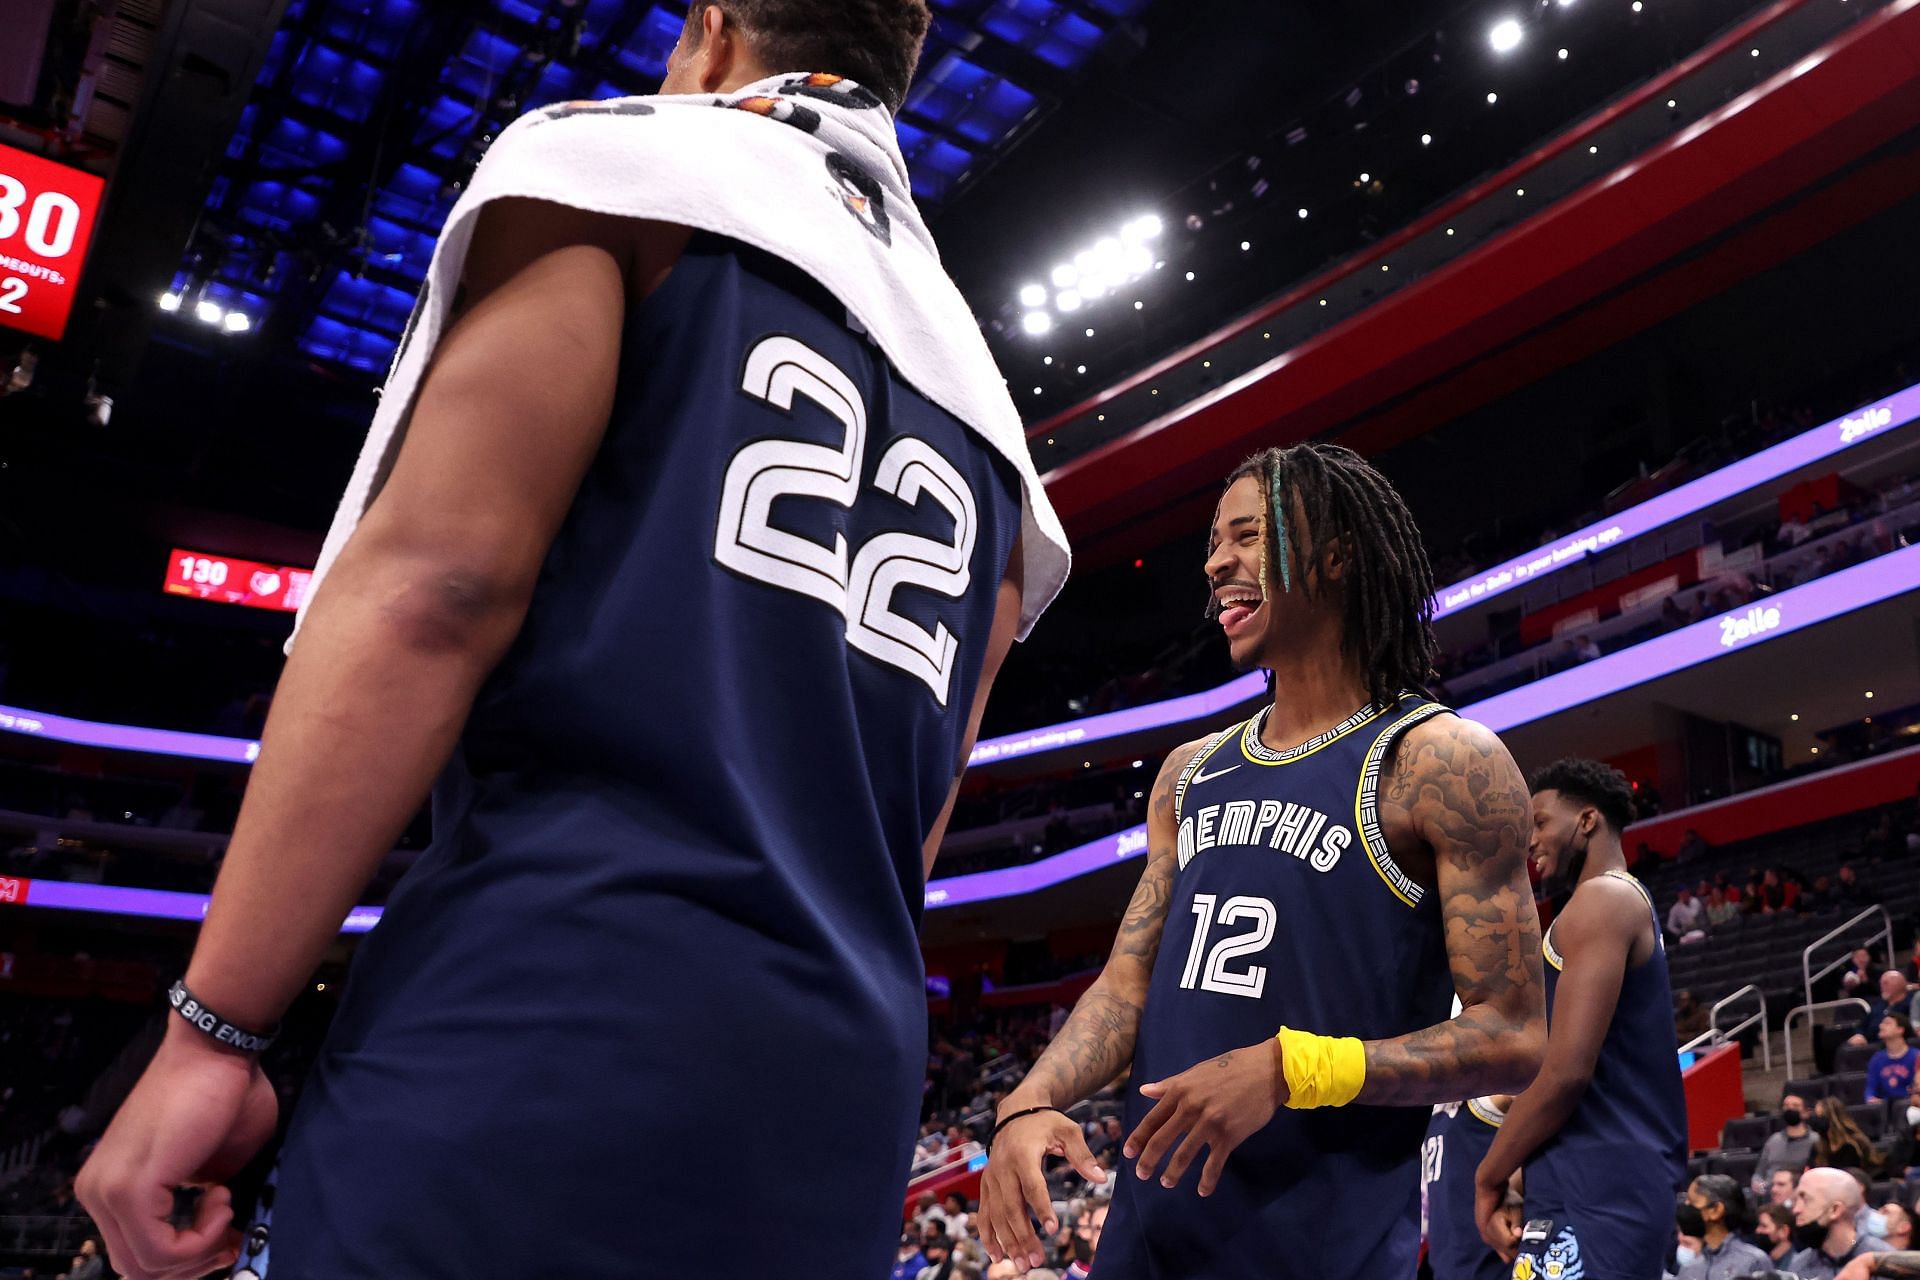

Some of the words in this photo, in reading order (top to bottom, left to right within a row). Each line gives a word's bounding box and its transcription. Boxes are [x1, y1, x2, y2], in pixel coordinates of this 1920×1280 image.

[0, 276, 29, 314] 2
[1840, 406, 1892, 443] Zelle
[714, 336, 977, 706] 22
[179, 556, 228, 586] 130
[1719, 606, 1780, 647] Zelle
[1177, 799, 1352, 873] MEMPHIS
[1179, 893, 1277, 999] 12
[180, 999, 217, 1032] BIG
